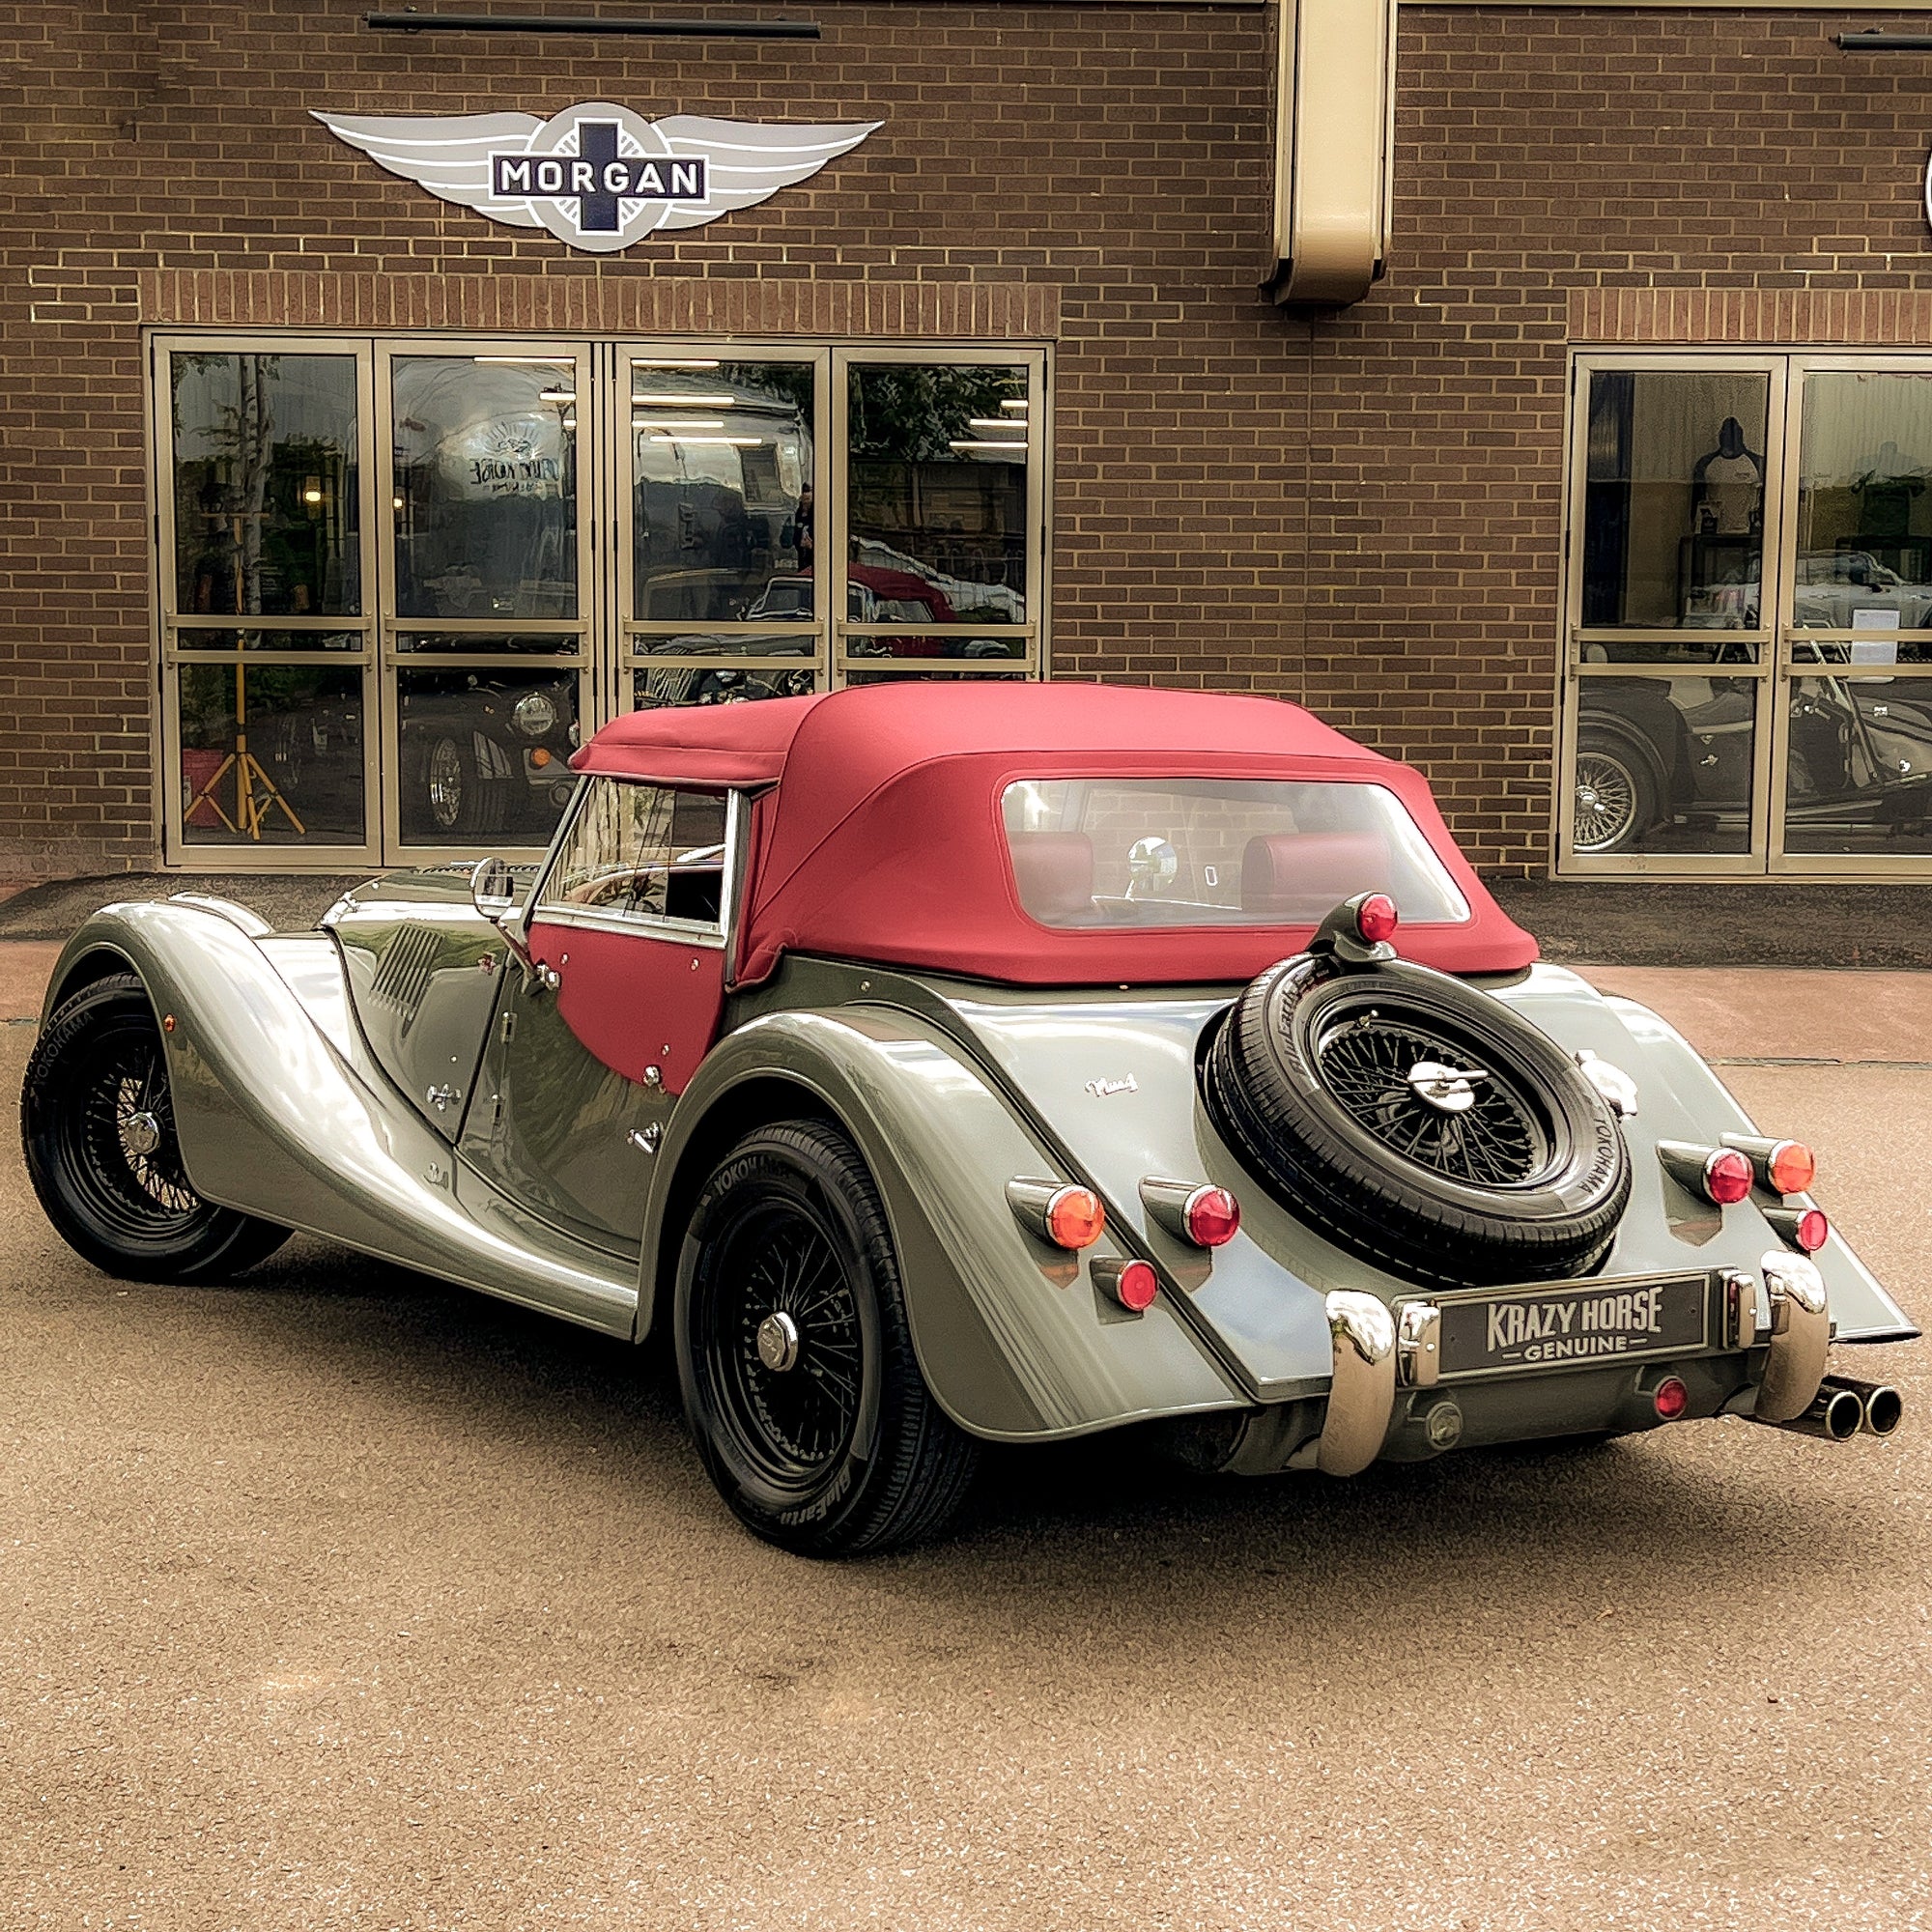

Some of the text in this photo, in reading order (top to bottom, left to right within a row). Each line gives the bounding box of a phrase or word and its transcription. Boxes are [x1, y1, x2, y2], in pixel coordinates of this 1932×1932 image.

[499, 158, 698, 195] MORGAN
[31, 1010, 95, 1086] YOKOHAMA
[1577, 1116, 1614, 1196] YOKOHAMA
[1487, 1286, 1663, 1352] KRAZY HORSE
[1523, 1335, 1627, 1361] GENUINE
